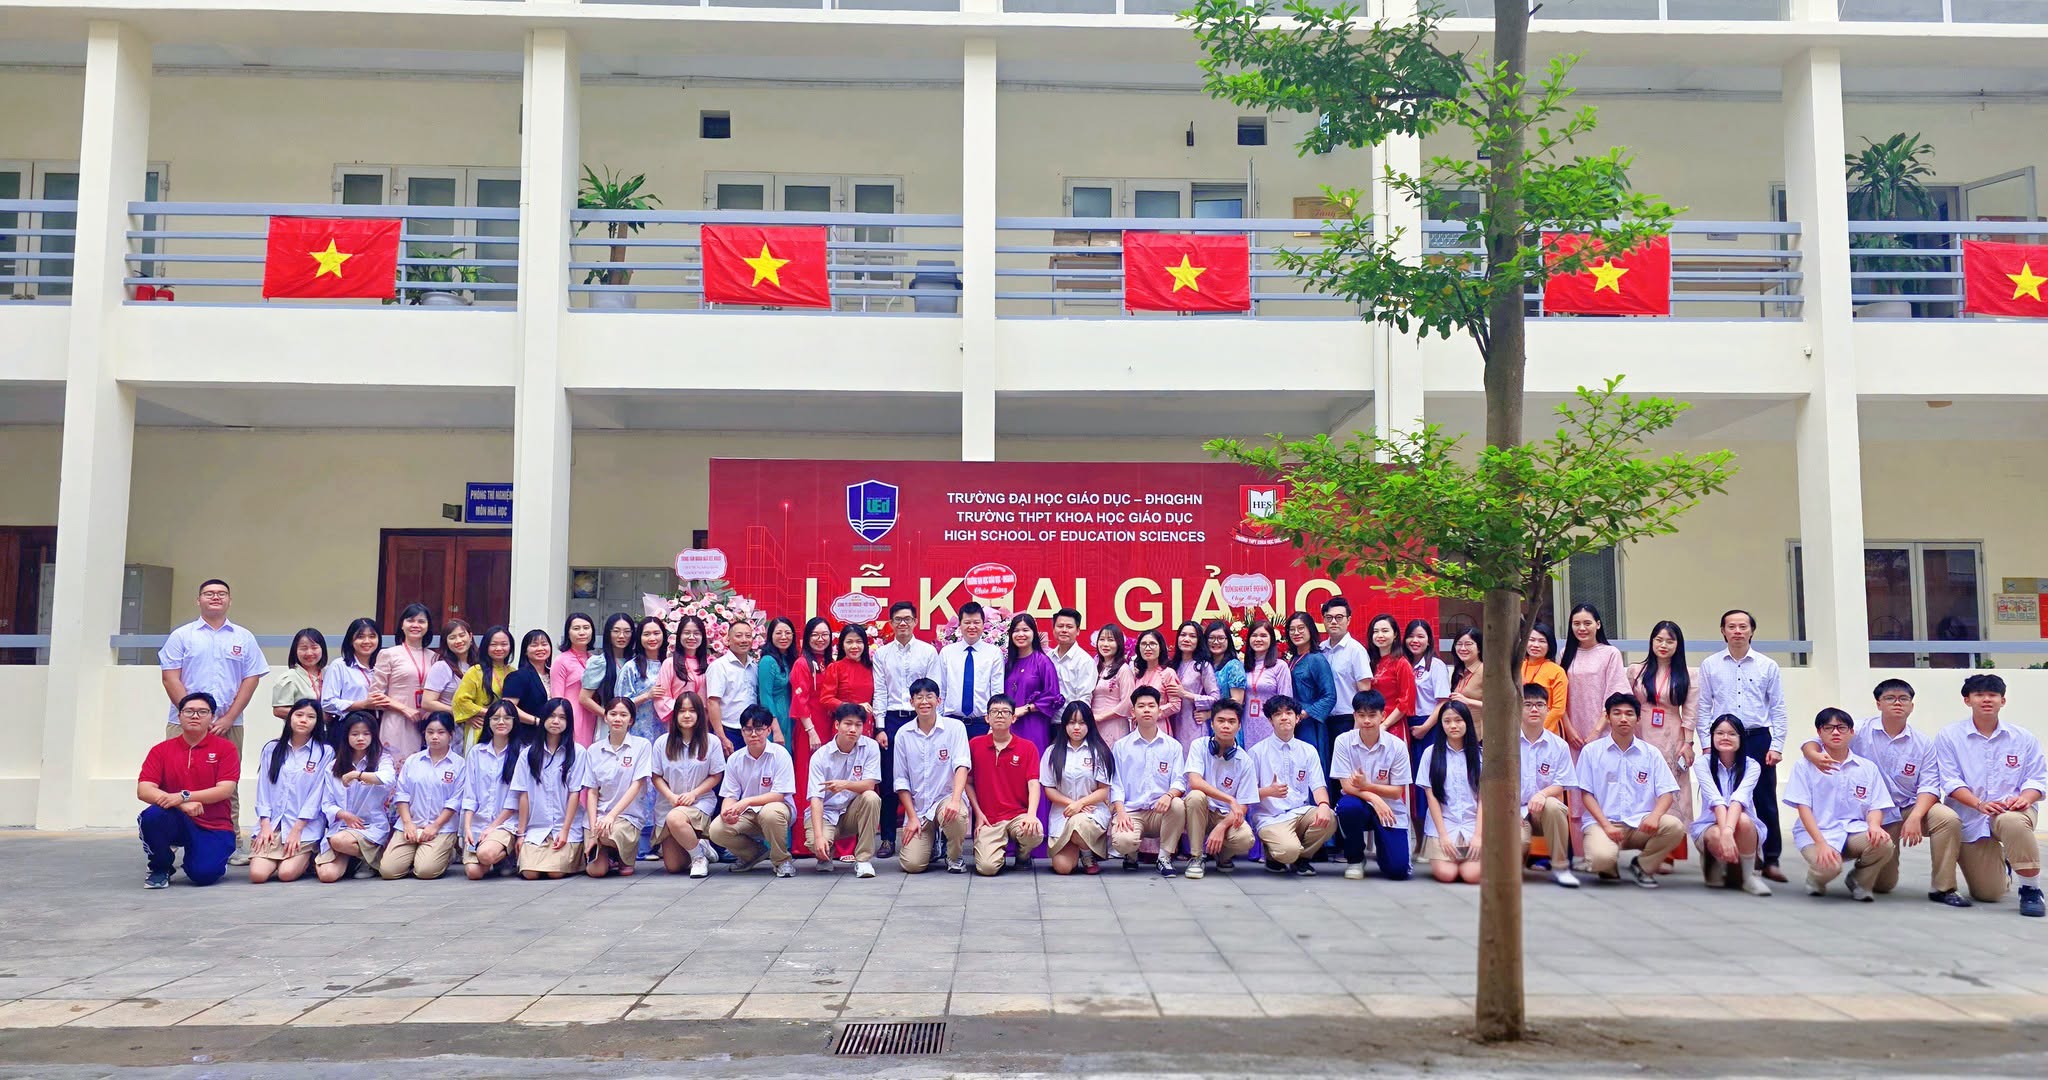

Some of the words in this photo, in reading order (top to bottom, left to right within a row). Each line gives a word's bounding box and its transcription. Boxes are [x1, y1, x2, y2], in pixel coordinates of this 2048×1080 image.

[947, 491, 1005, 504] TRƯỜNG
[1008, 493, 1031, 507] ĐẠI
[1035, 493, 1063, 507] HỌC
[1066, 491, 1100, 505] GIÁO
[1103, 493, 1131, 507] DỤC
[1145, 494, 1203, 506] ĐHQGHN
[956, 509, 1015, 523] TRƯỜNG
[1018, 512, 1052, 523] THPT
[1055, 512, 1094, 523] KHOA
[1096, 512, 1125, 526] HỌC
[1128, 510, 1162, 523] GIÁO
[1165, 512, 1193, 526] DỤC
[944, 530, 977, 541] HIGH
[980, 530, 1035, 541] SCHOOL
[1038, 530, 1057, 541] OF
[1060, 531, 1136, 542] EDUCATION
[1139, 531, 1206, 542] SCIENCES
[920, 577, 1087, 631] KAI
